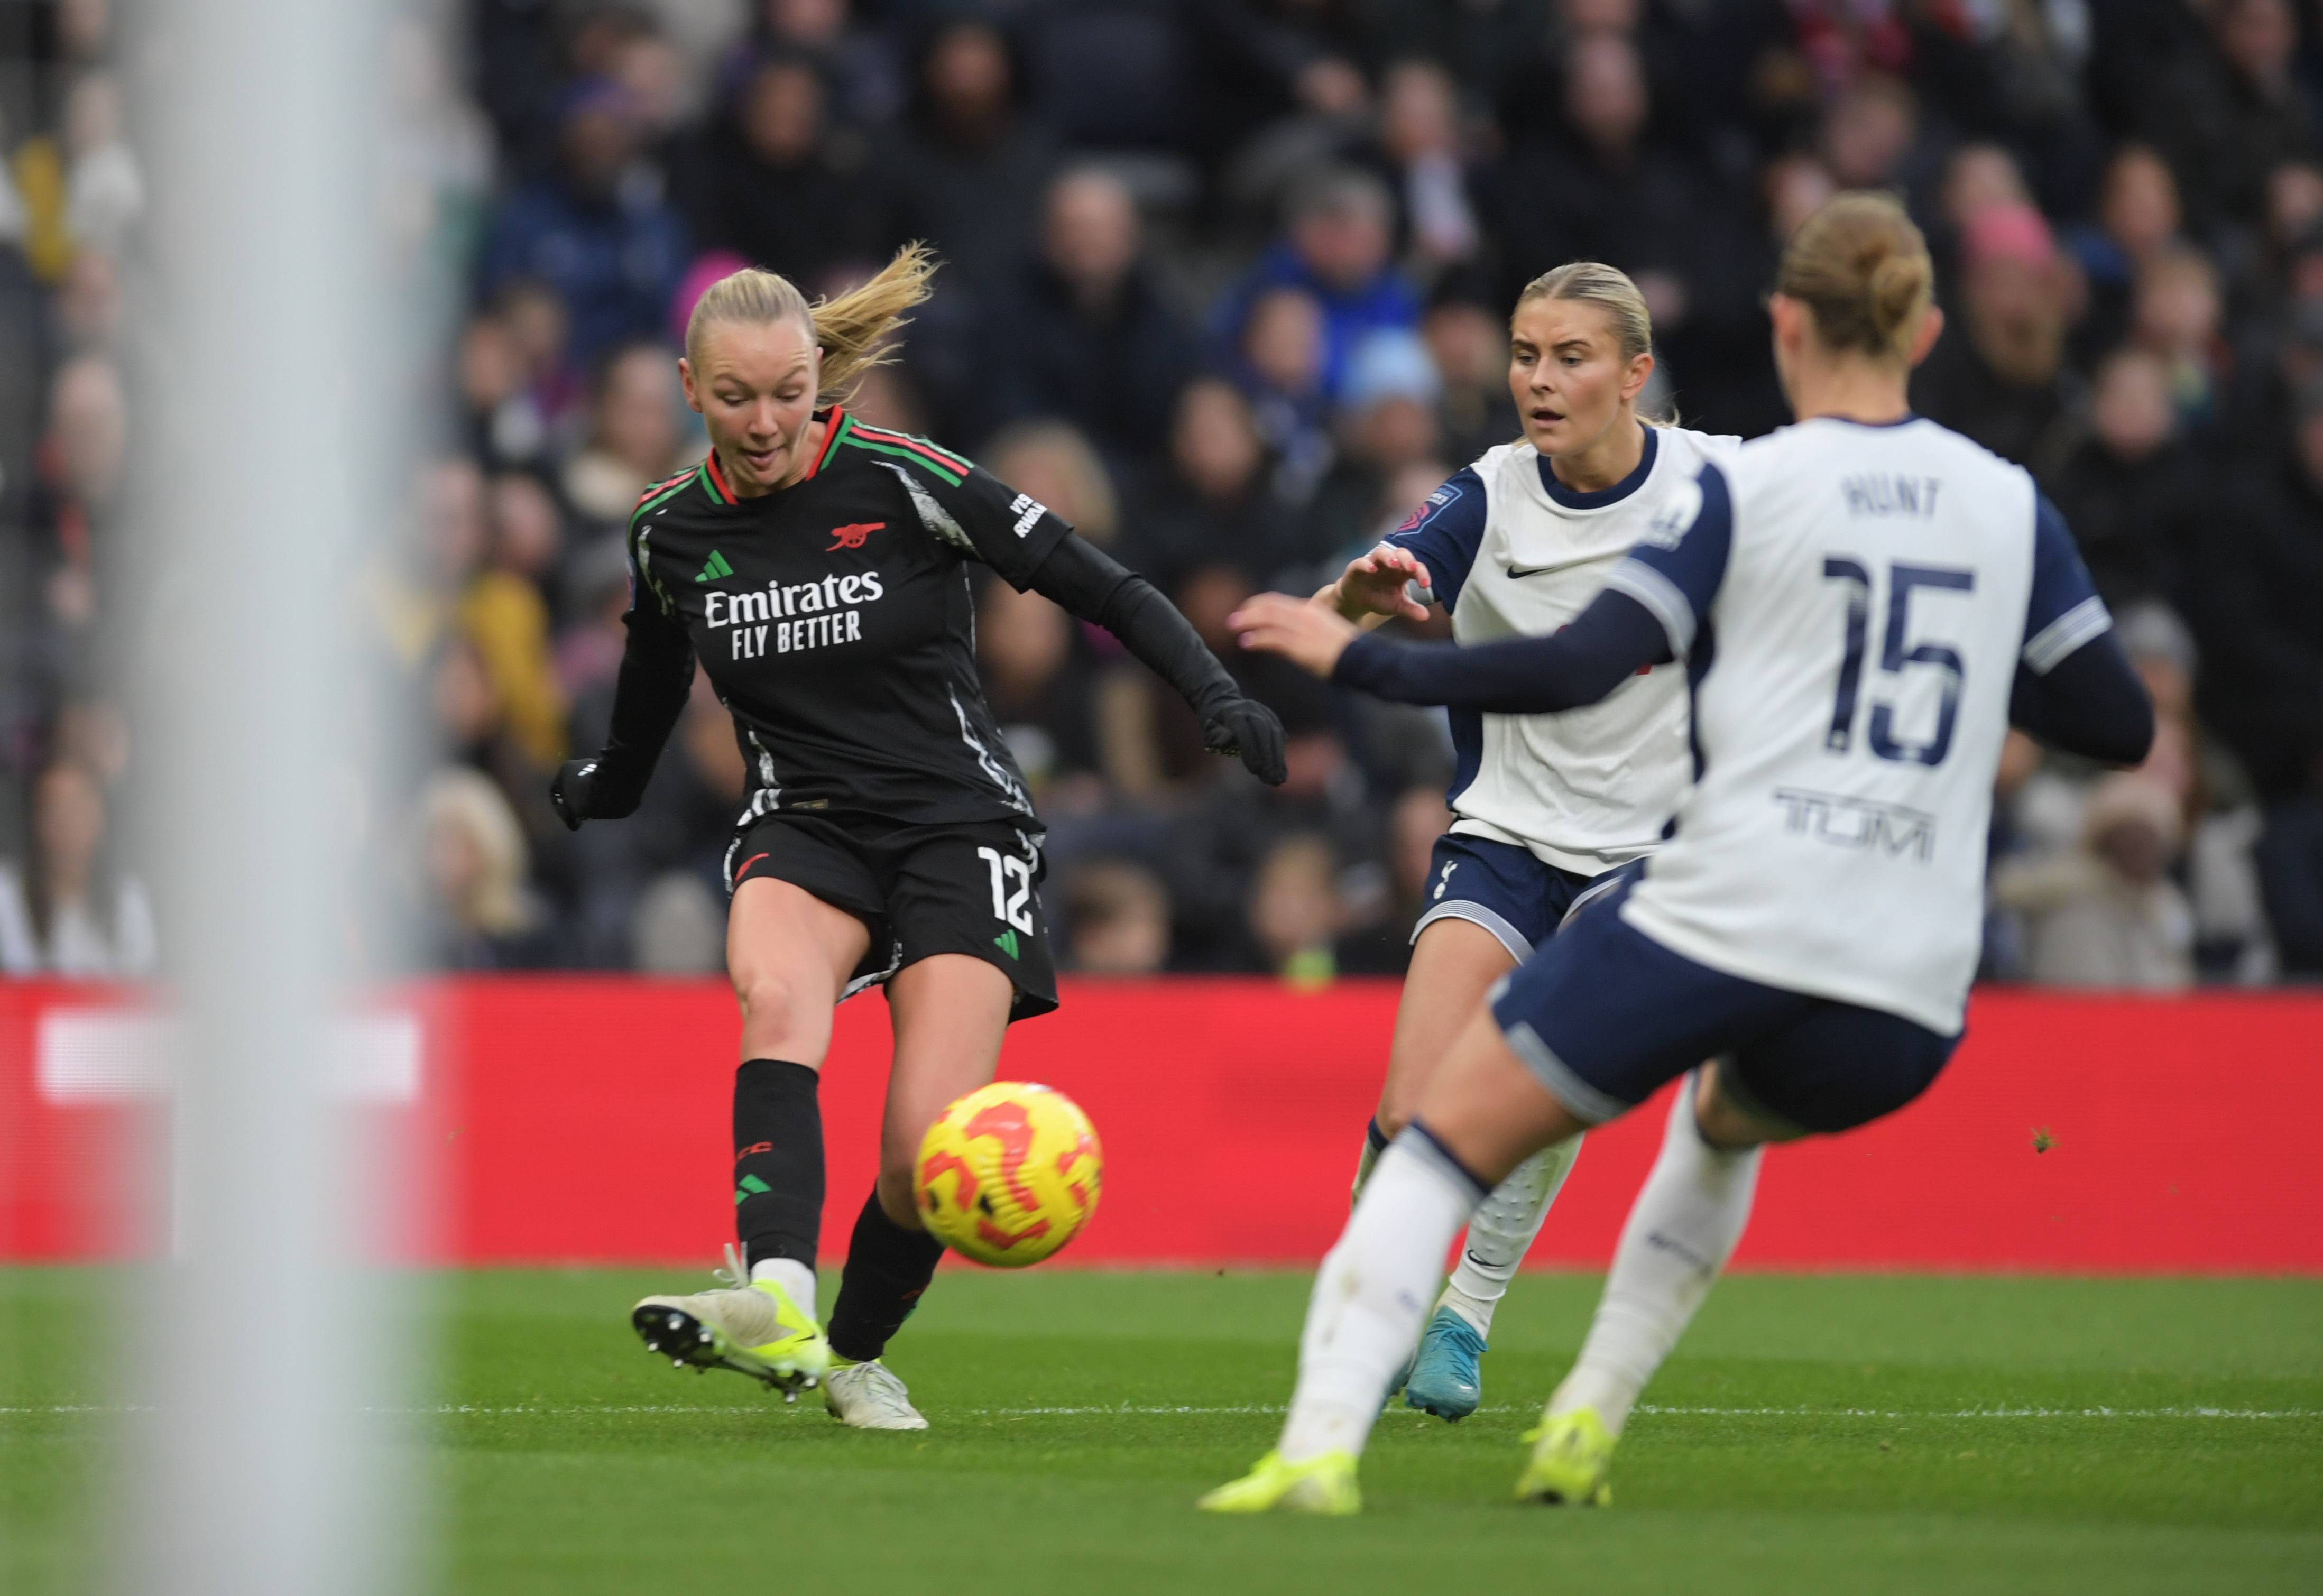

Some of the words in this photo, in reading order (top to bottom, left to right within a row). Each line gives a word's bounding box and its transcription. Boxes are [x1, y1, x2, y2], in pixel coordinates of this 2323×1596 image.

[1840, 472, 1943, 520] HUNT
[705, 571, 883, 628] Emirates
[732, 625, 769, 660] FLY
[777, 610, 862, 653] BETTER
[1823, 557, 1977, 766] 15
[977, 846, 1034, 936] 12
